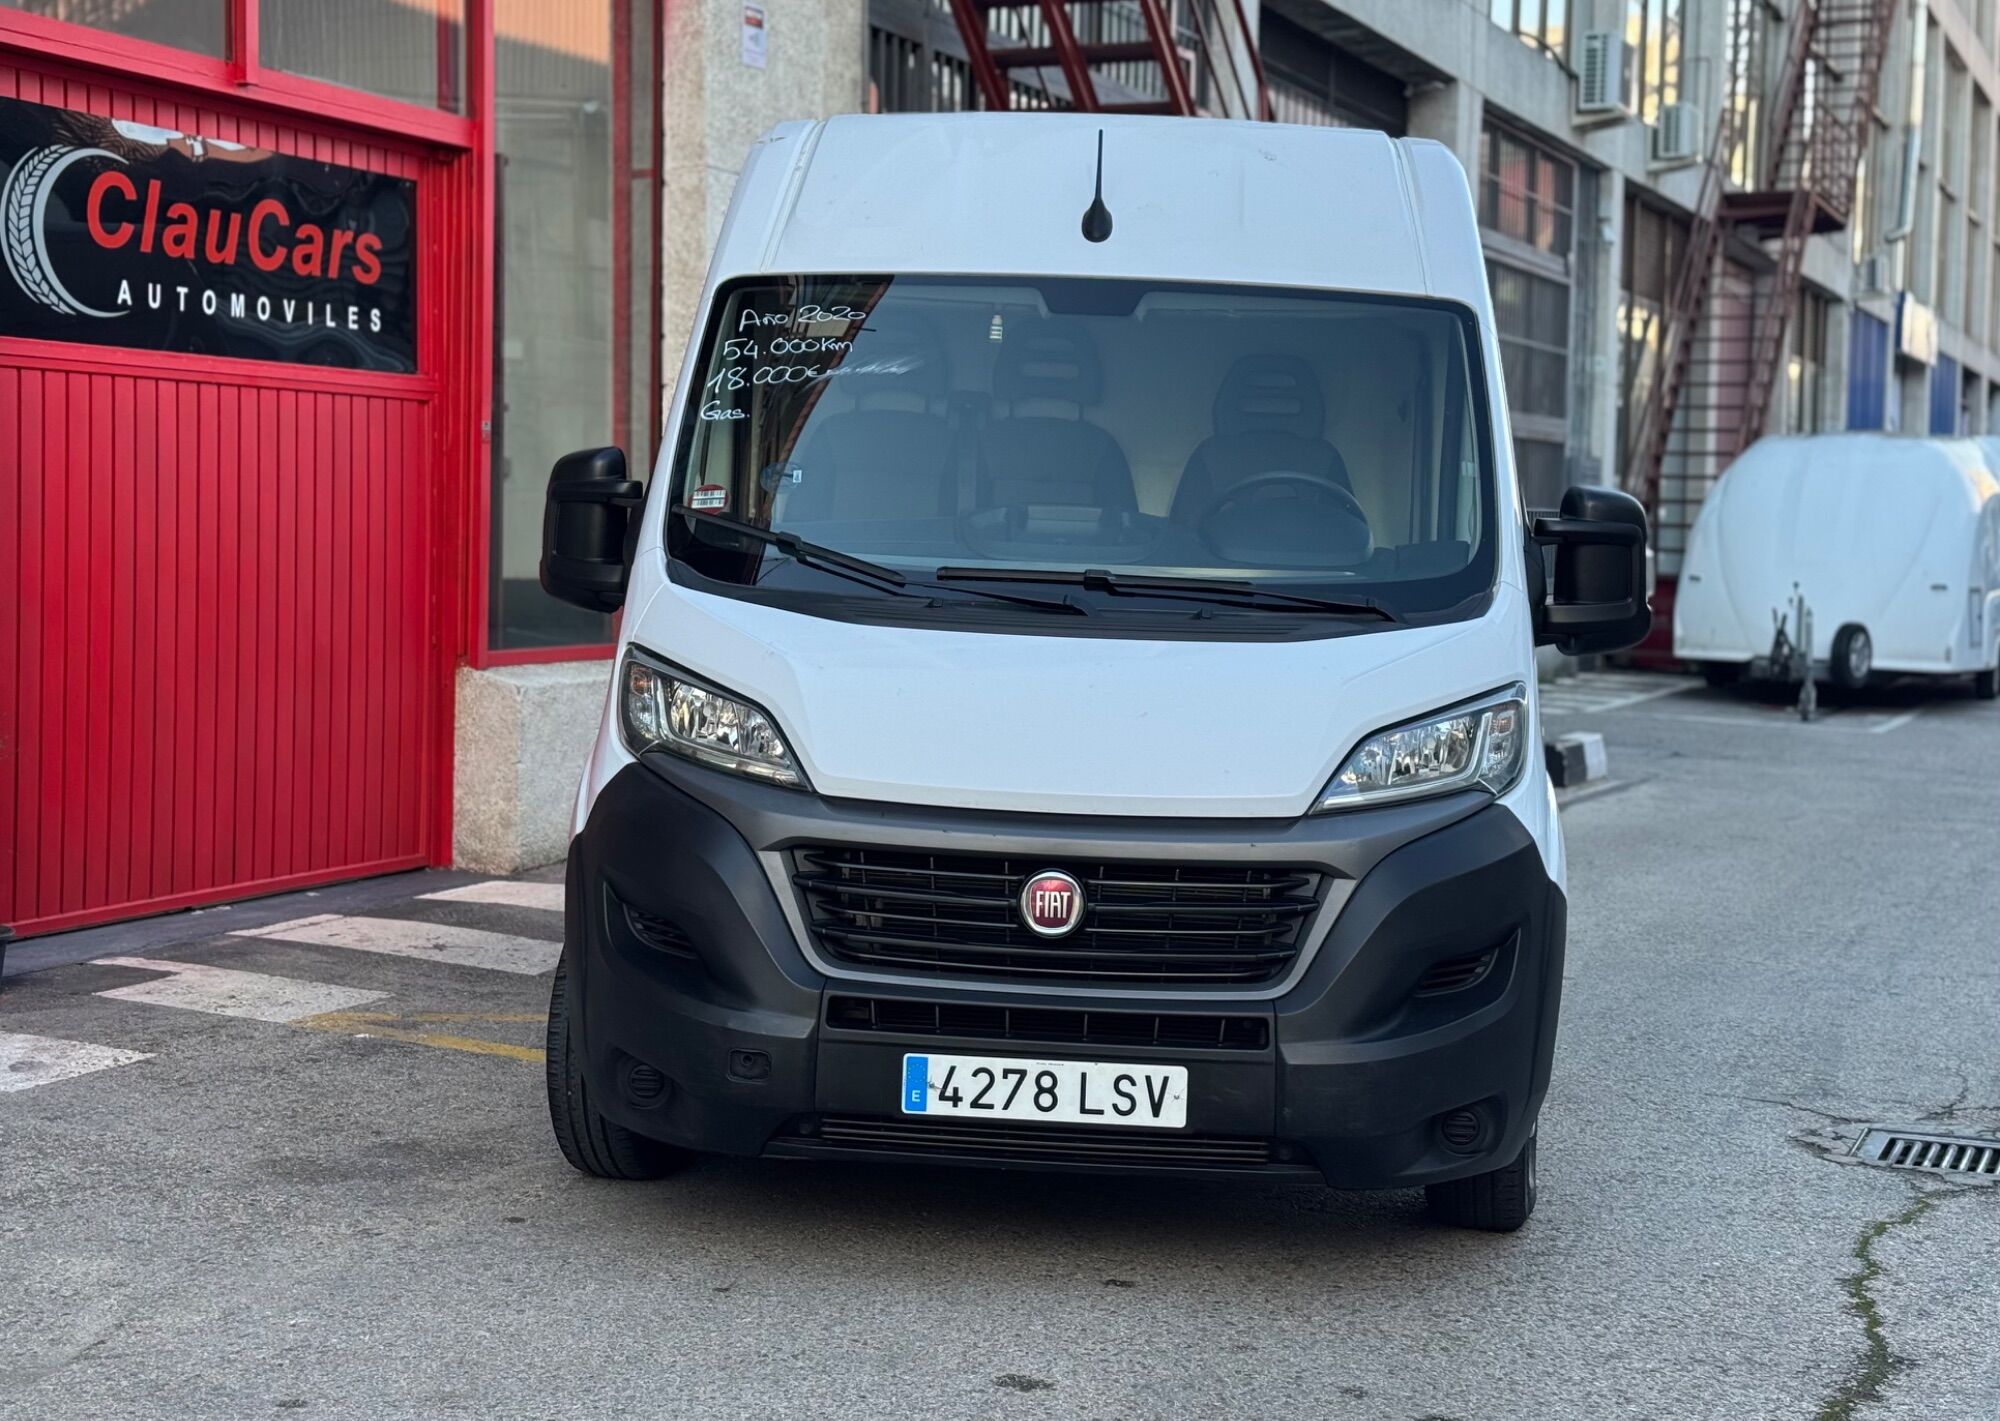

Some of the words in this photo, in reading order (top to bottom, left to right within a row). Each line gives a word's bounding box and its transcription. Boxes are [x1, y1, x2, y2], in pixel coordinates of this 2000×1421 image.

[86, 170, 383, 285] ClauCars
[117, 279, 382, 332] AUTOMOVILES
[739, 309, 789, 332] Año
[798, 305, 866, 323] 2020
[700, 400, 750, 420] Gas.
[1035, 891, 1072, 918] FIAT
[911, 1090, 921, 1102] E
[938, 1065, 1059, 1113] 4278
[1079, 1071, 1170, 1118] LSV
